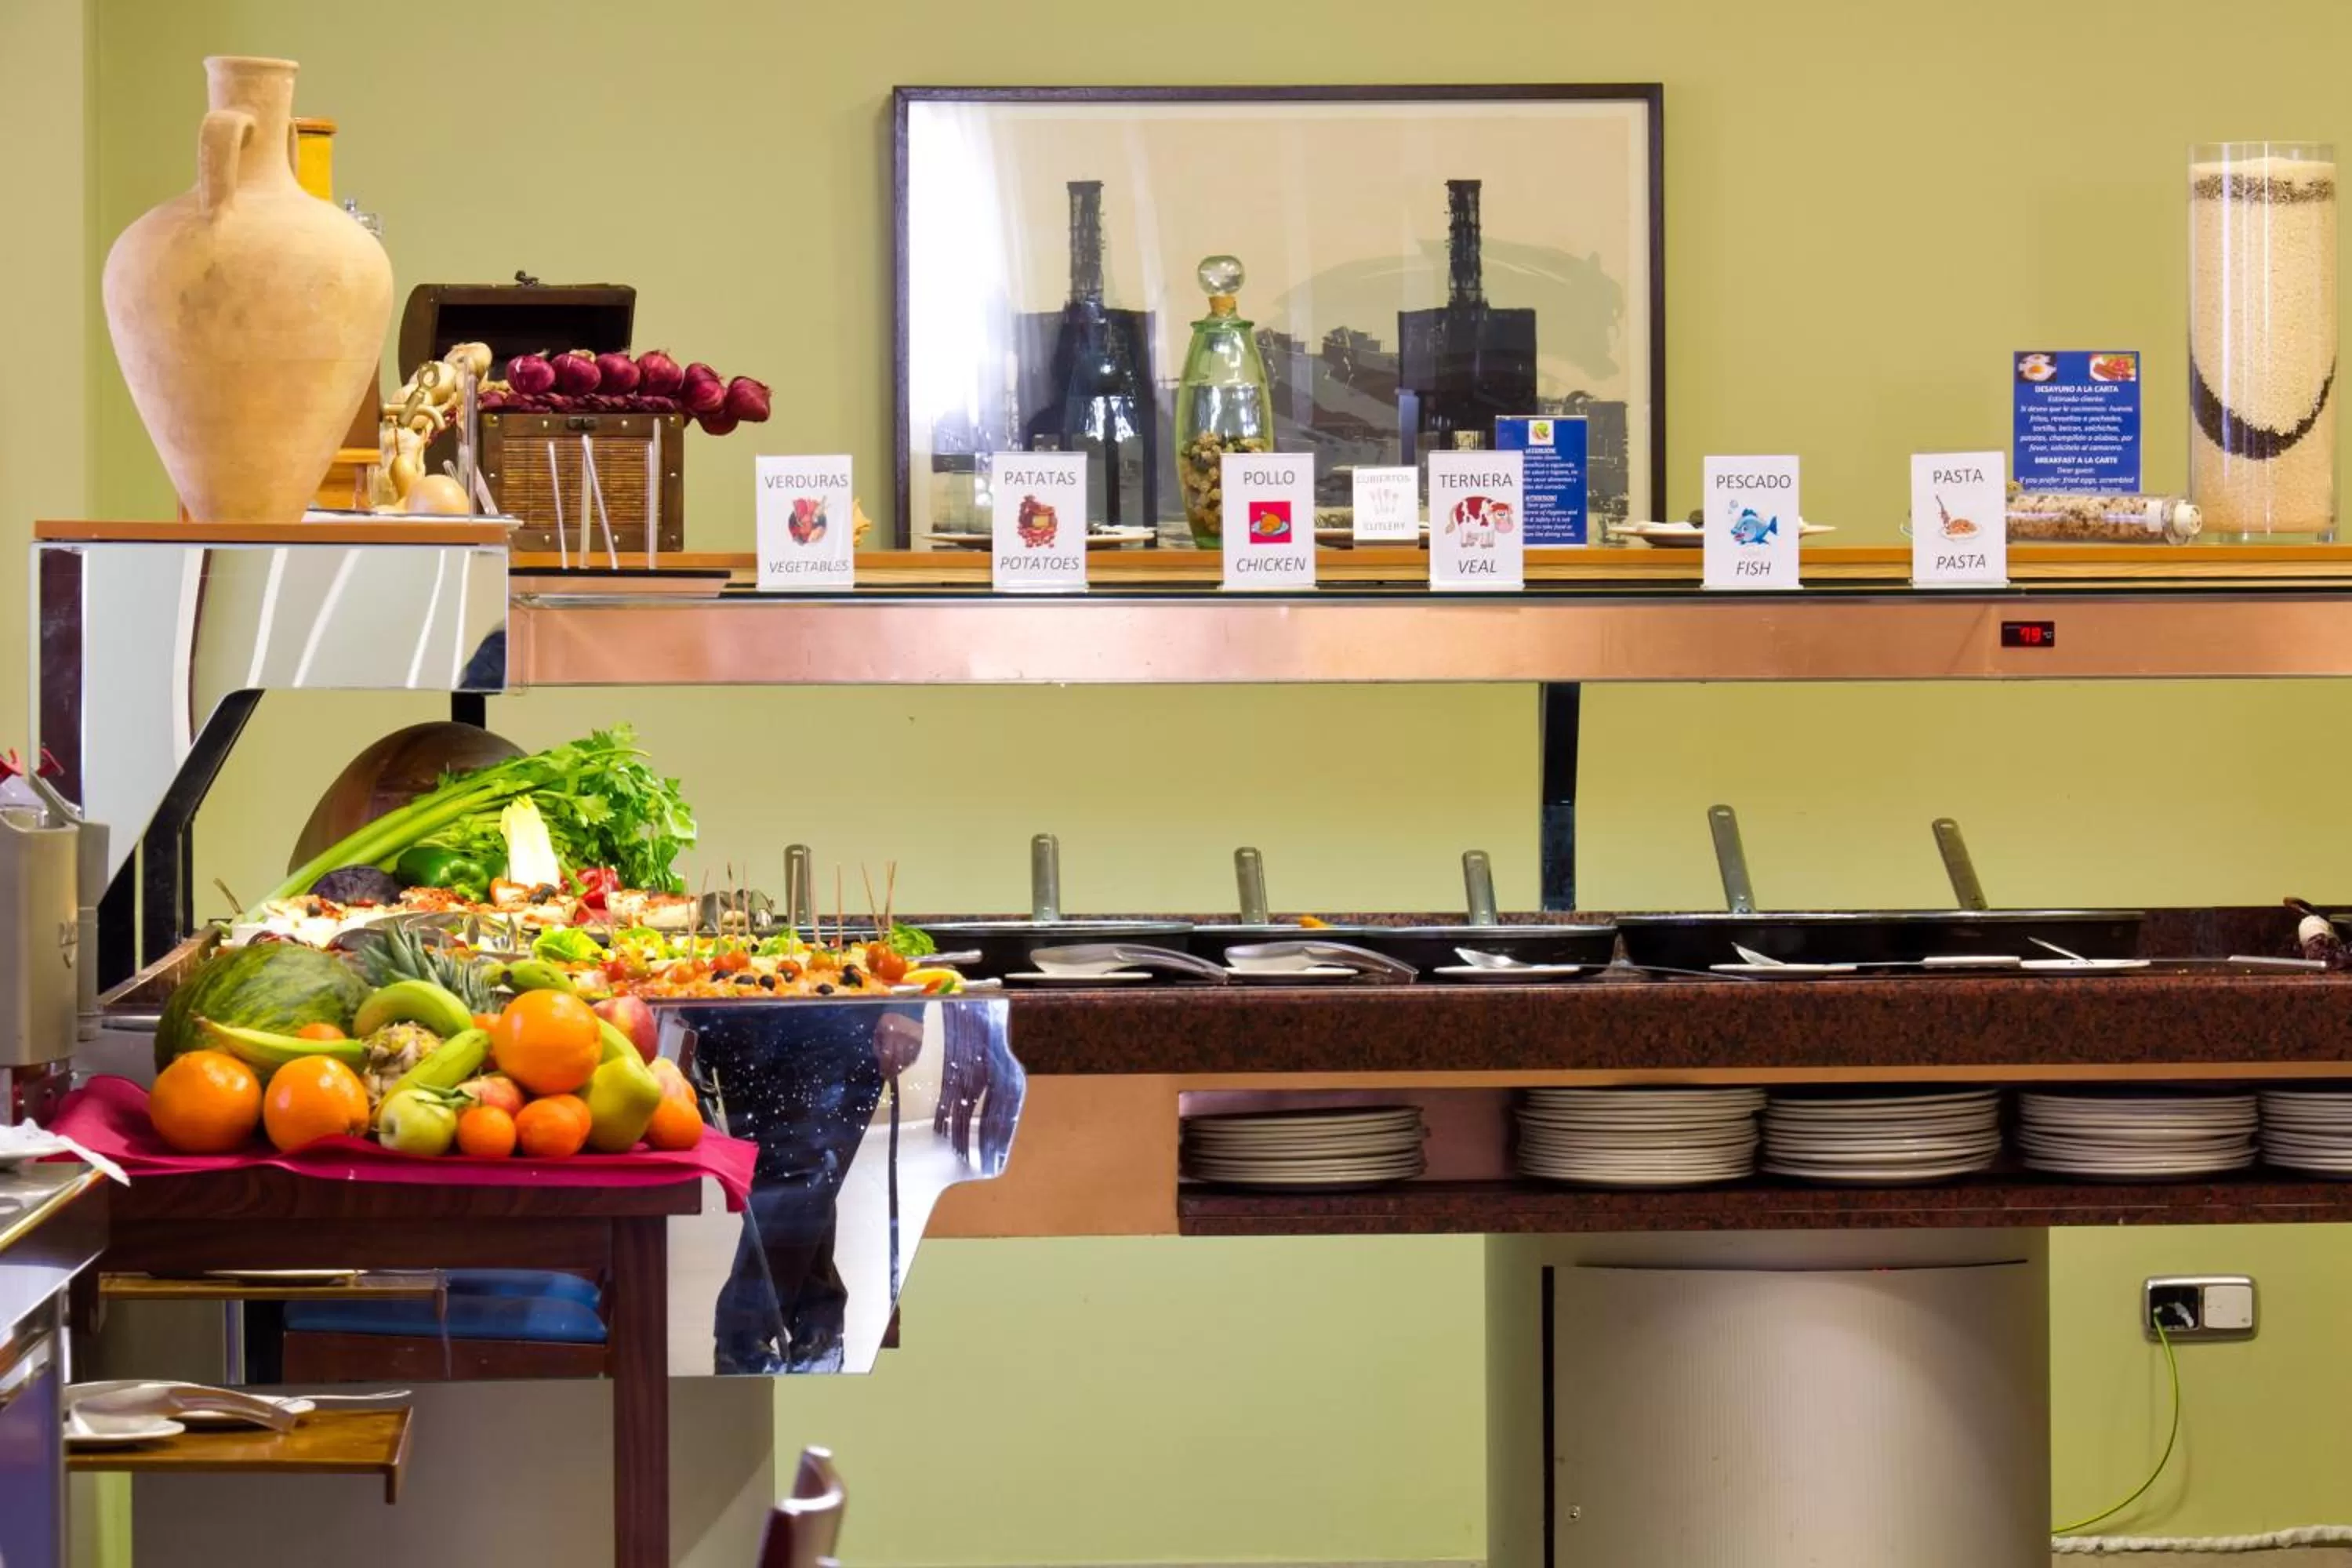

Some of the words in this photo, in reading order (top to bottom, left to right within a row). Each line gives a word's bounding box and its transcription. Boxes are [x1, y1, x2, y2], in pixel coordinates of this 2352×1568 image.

[764, 474, 848, 488] VERDURAS
[1004, 471, 1076, 485] PATATAS
[1243, 470, 1295, 485] POLLO
[1439, 474, 1513, 488] TERNERA
[1716, 474, 1791, 489] PESCADO
[1933, 469, 1984, 484] PASTA
[769, 560, 848, 573] VEGETABLES
[1000, 557, 1079, 570] POTATOES
[1236, 557, 1306, 572] CHICKEN
[1458, 559, 1497, 573] VEAL
[1737, 561, 1771, 575] FISH
[1936, 554, 1986, 570] PASTA
